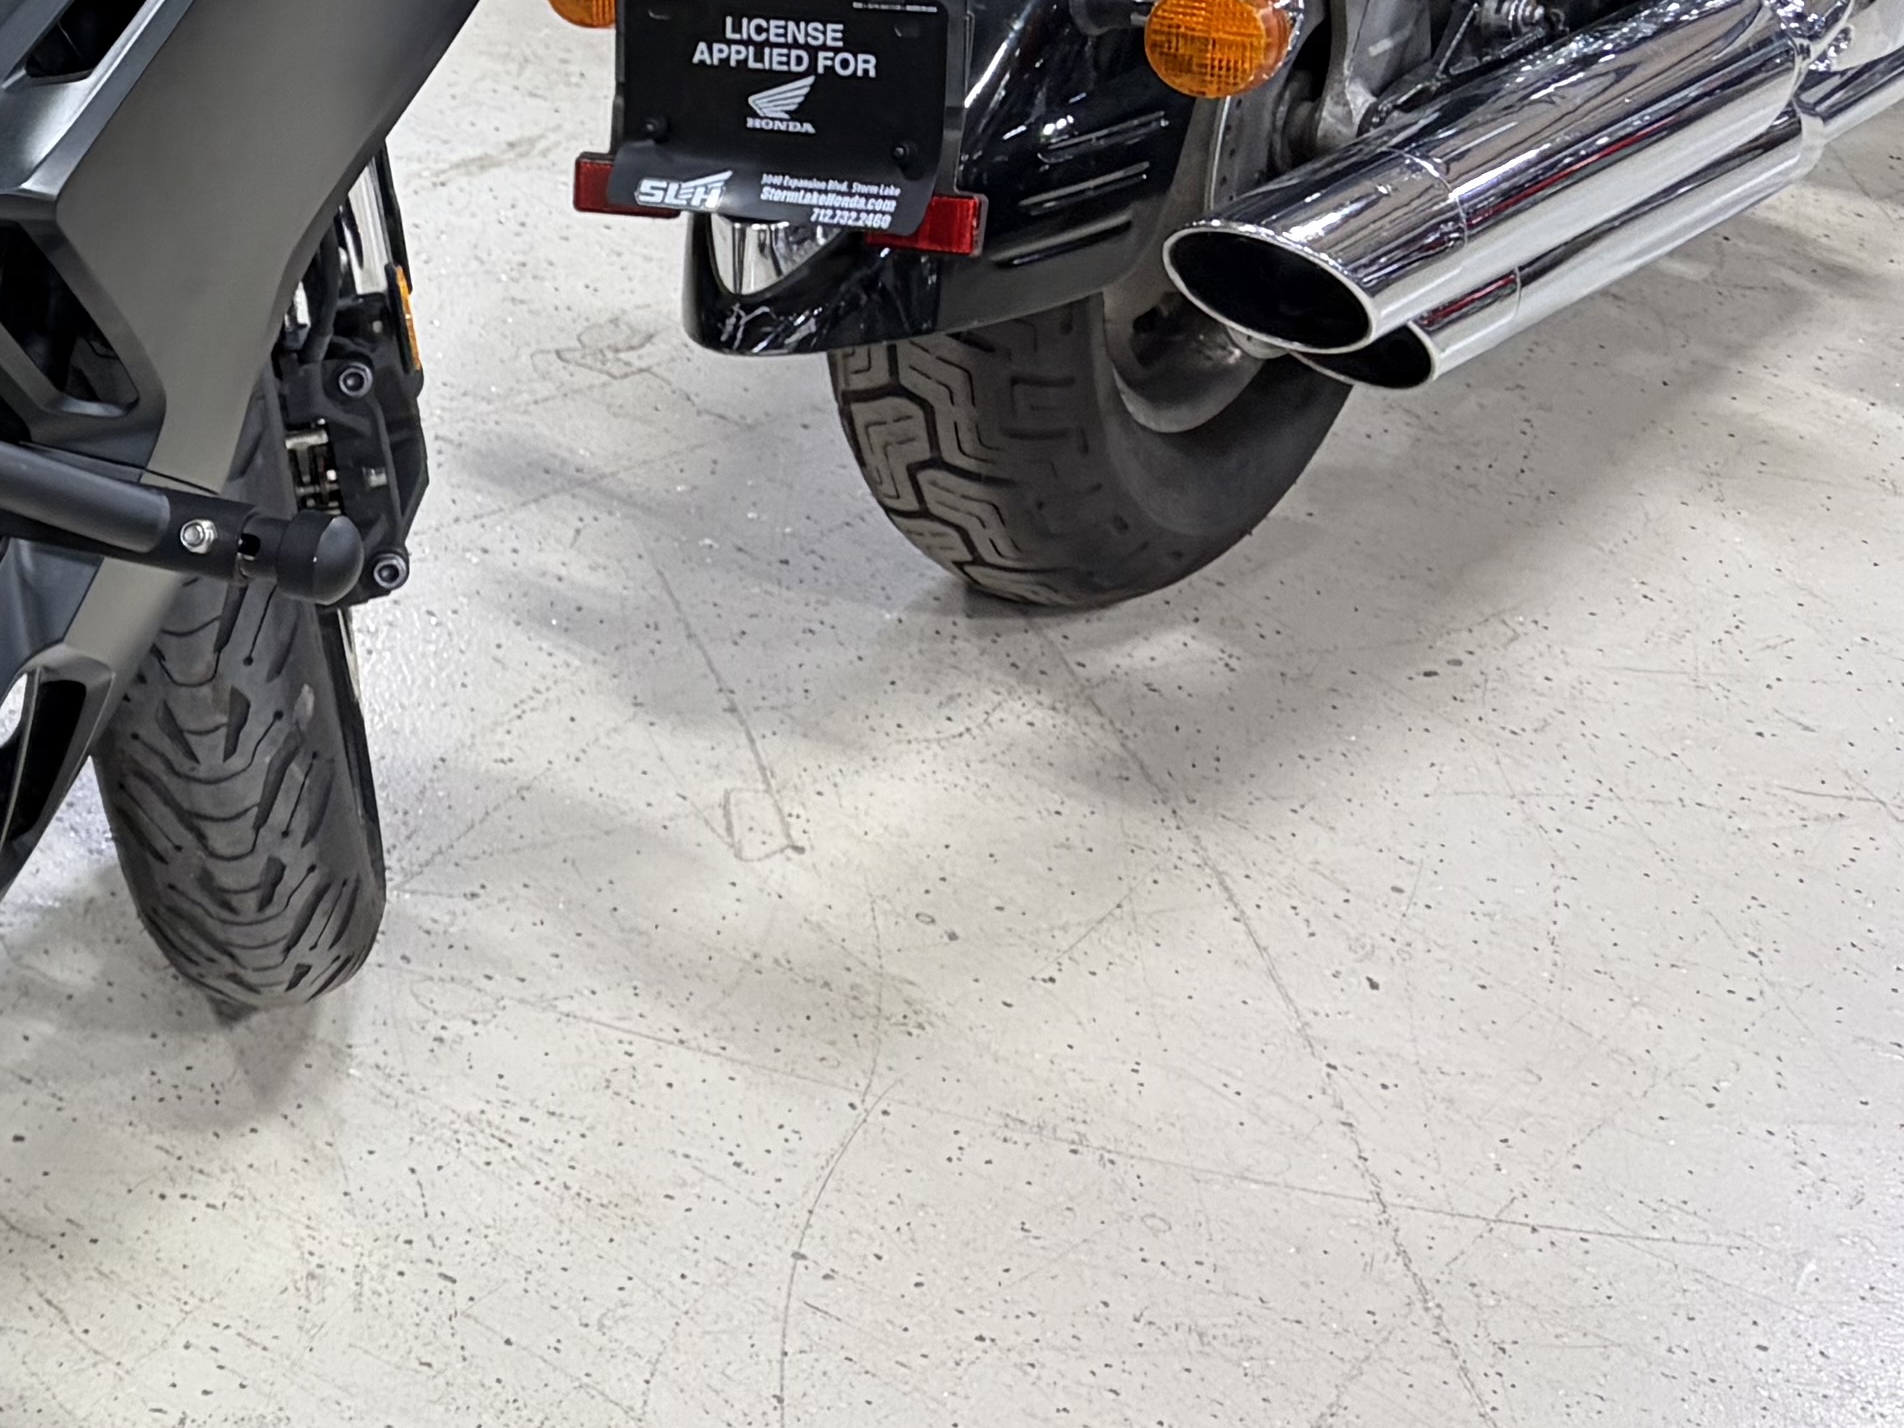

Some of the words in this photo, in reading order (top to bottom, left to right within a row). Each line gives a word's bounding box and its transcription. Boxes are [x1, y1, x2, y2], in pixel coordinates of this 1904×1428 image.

[725, 15, 844, 47] LICENSE
[692, 41, 810, 73] APPLIED
[817, 51, 877, 78] FOR
[746, 117, 816, 134] HONDA
[760, 187, 897, 213] StormLakeHonda.com
[810, 208, 892, 230] 712.732.2460
